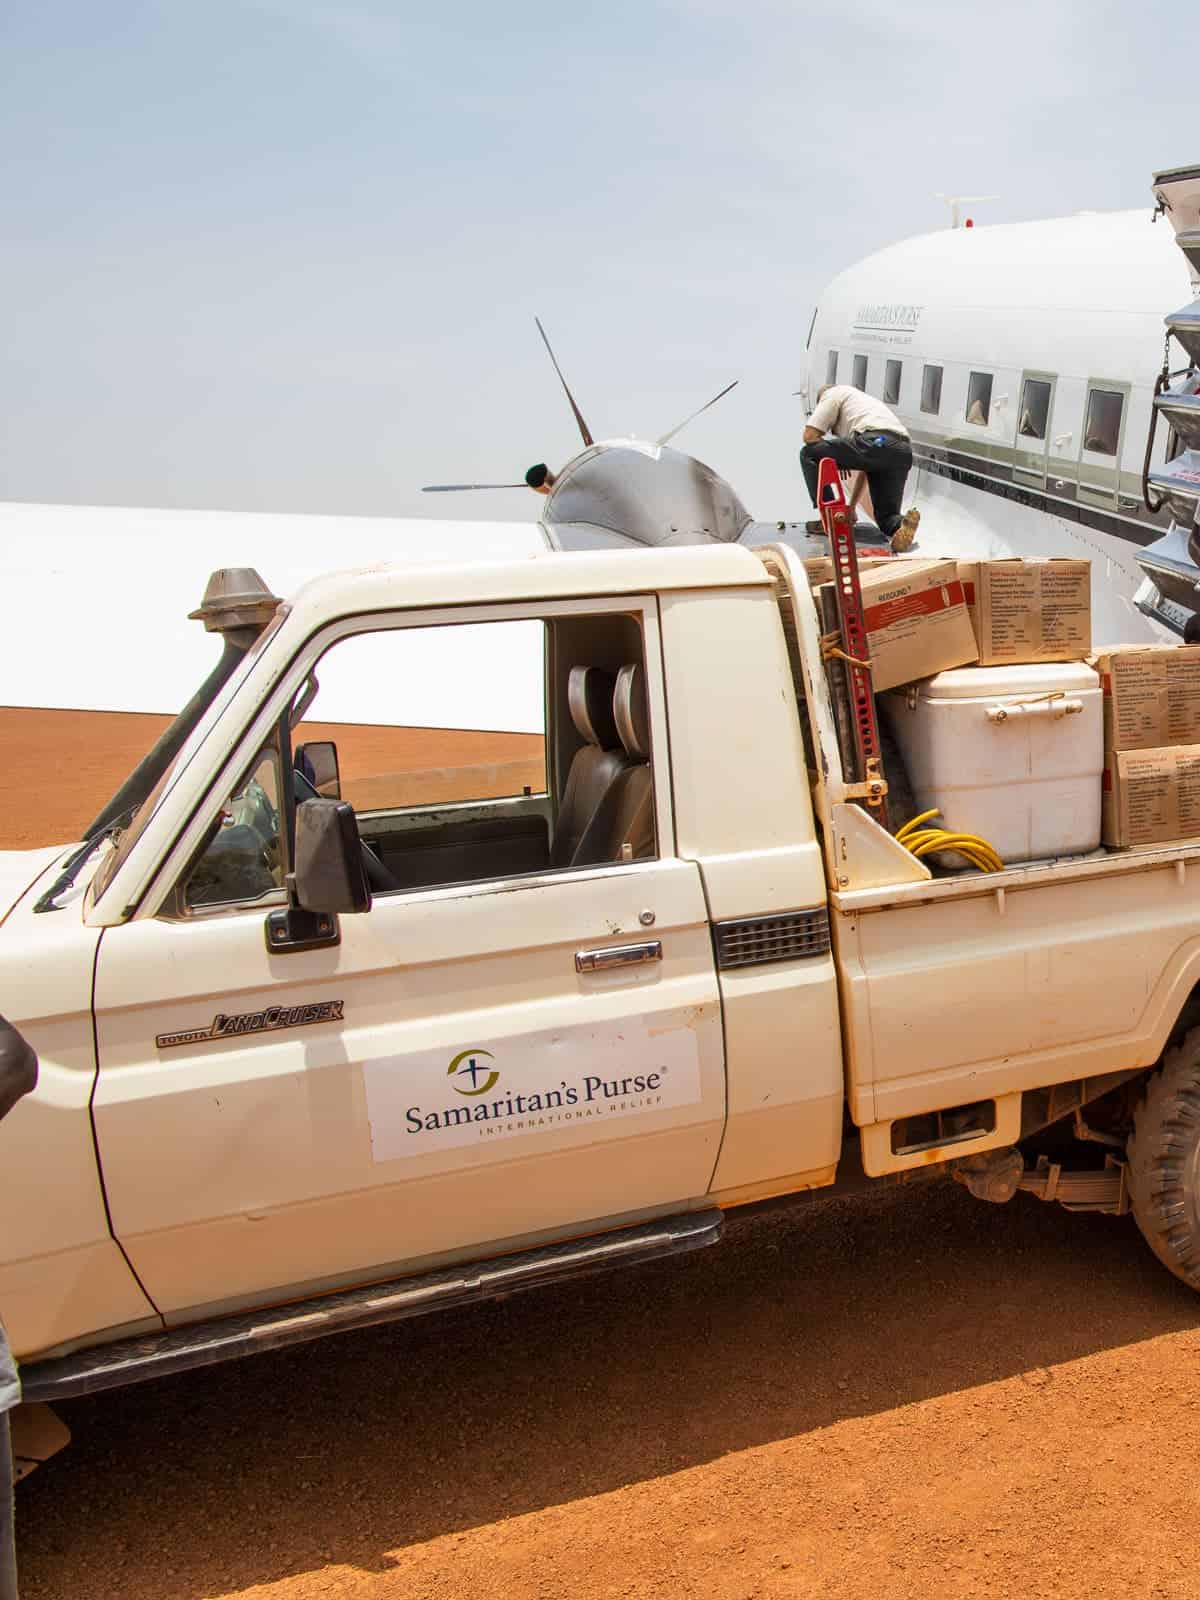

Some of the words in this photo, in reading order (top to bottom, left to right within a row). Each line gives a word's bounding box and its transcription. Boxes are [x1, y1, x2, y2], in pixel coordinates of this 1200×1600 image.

[159, 1031, 210, 1046] TOYOTA
[405, 1081, 578, 1134] Samaritan's
[479, 1108, 603, 1137] INTERNATIONAL
[610, 1095, 663, 1113] RELIEF
